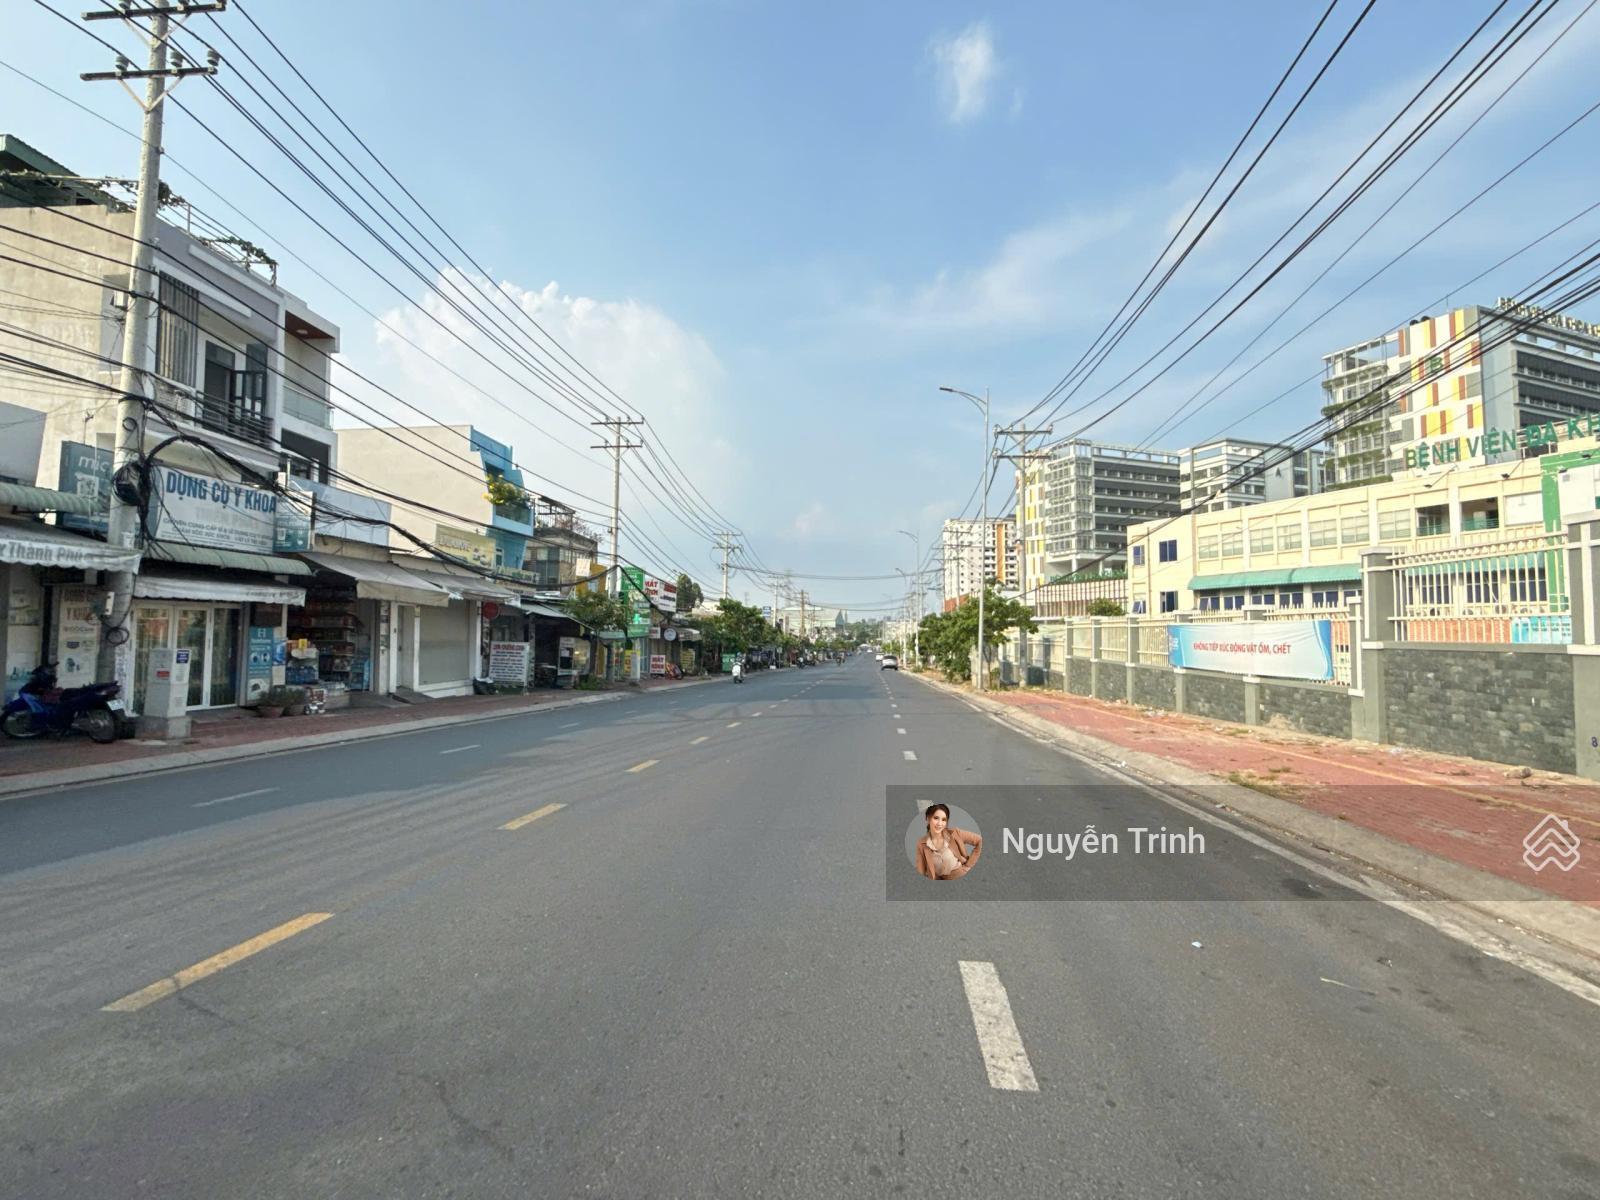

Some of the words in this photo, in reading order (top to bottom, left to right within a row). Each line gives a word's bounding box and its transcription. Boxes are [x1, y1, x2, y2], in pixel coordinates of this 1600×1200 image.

[1405, 437, 1461, 470] BỆNH
[1467, 427, 1516, 458] VIỆN
[1525, 421, 1558, 448] ĐA
[166, 471, 207, 501] DỤNG
[211, 481, 230, 509] CỤ
[234, 485, 243, 507] Y
[244, 489, 277, 513] KHOA
[1193, 641, 1209, 652] KHÔNG
[1209, 641, 1219, 652] TIẾP
[1219, 641, 1229, 653] XÚC
[1230, 641, 1246, 654] ĐỘNG
[1246, 641, 1258, 655] VẬT
[1258, 641, 1272, 655] ỐM,
[1272, 641, 1292, 655] CHẾT
